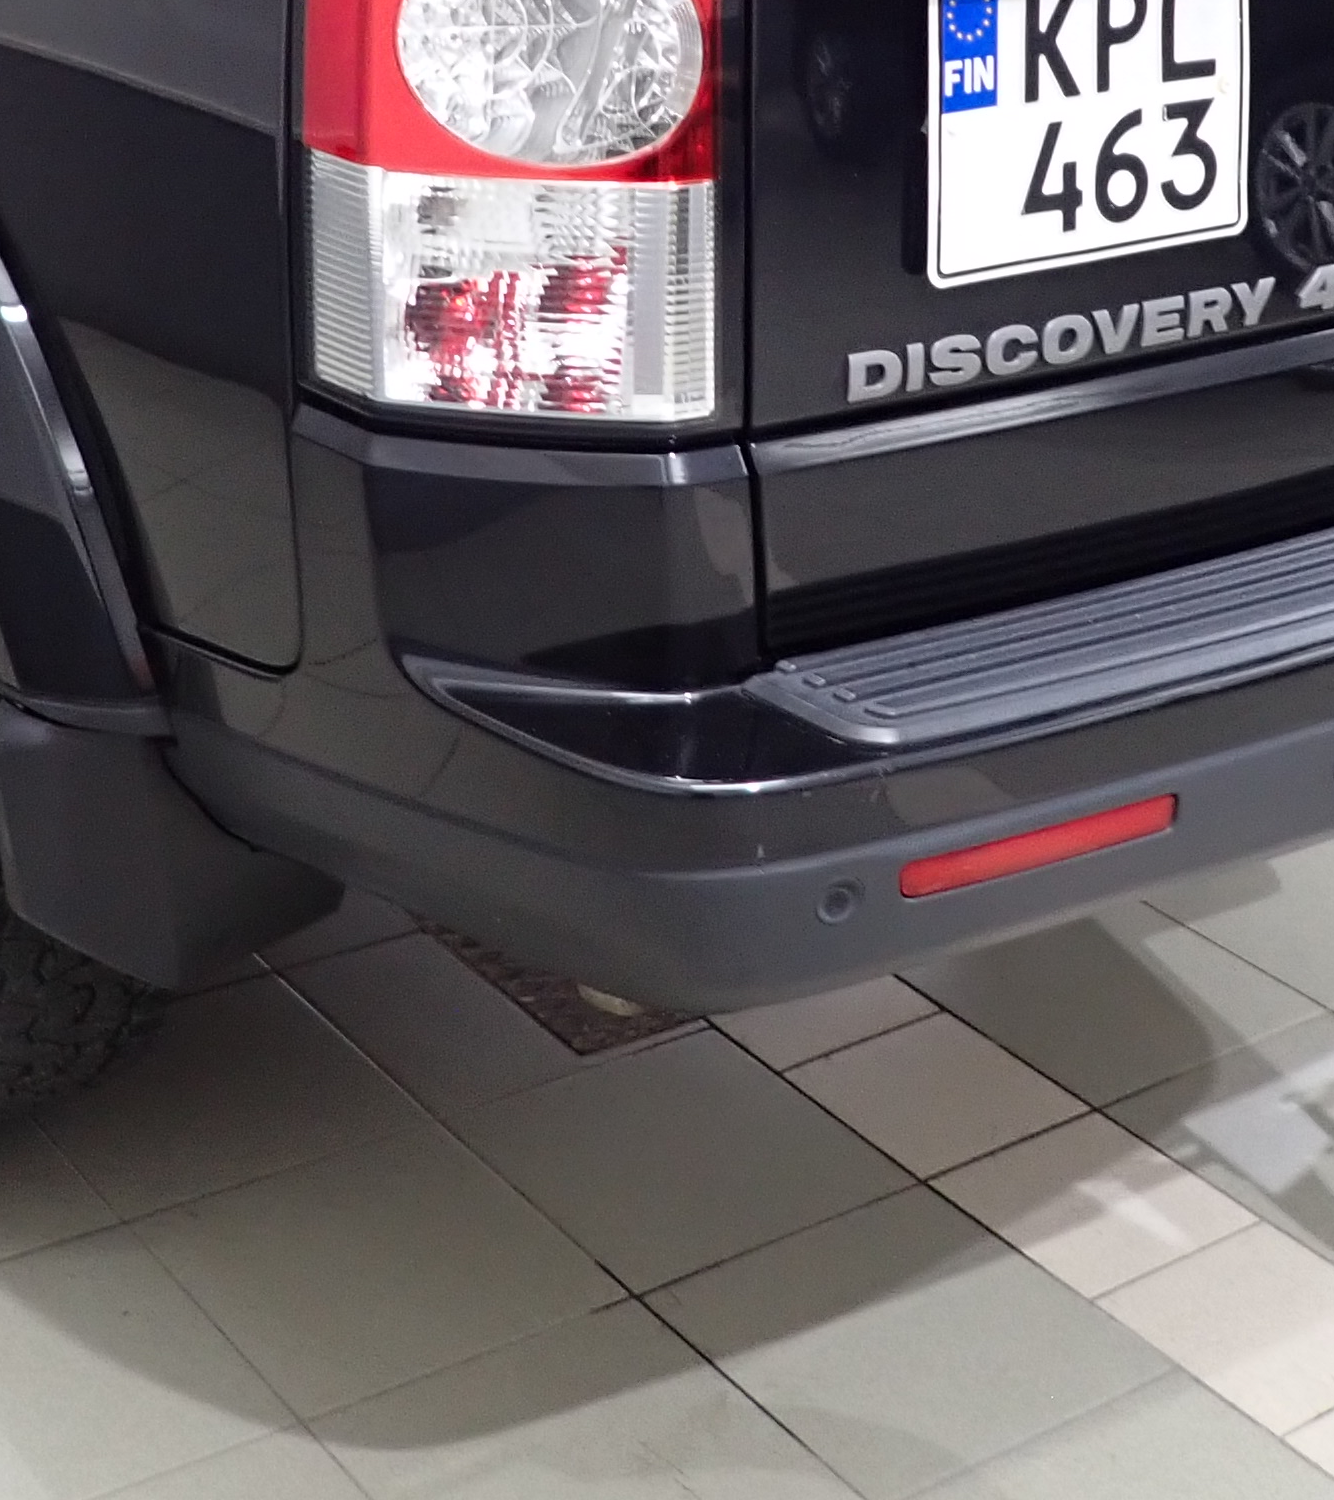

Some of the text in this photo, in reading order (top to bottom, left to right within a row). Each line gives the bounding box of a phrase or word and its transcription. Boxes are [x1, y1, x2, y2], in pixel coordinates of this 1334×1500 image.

[944, 55, 995, 98] FIN
[1021, 97, 1218, 233] 463
[847, 276, 1275, 403] DISCOVERY
